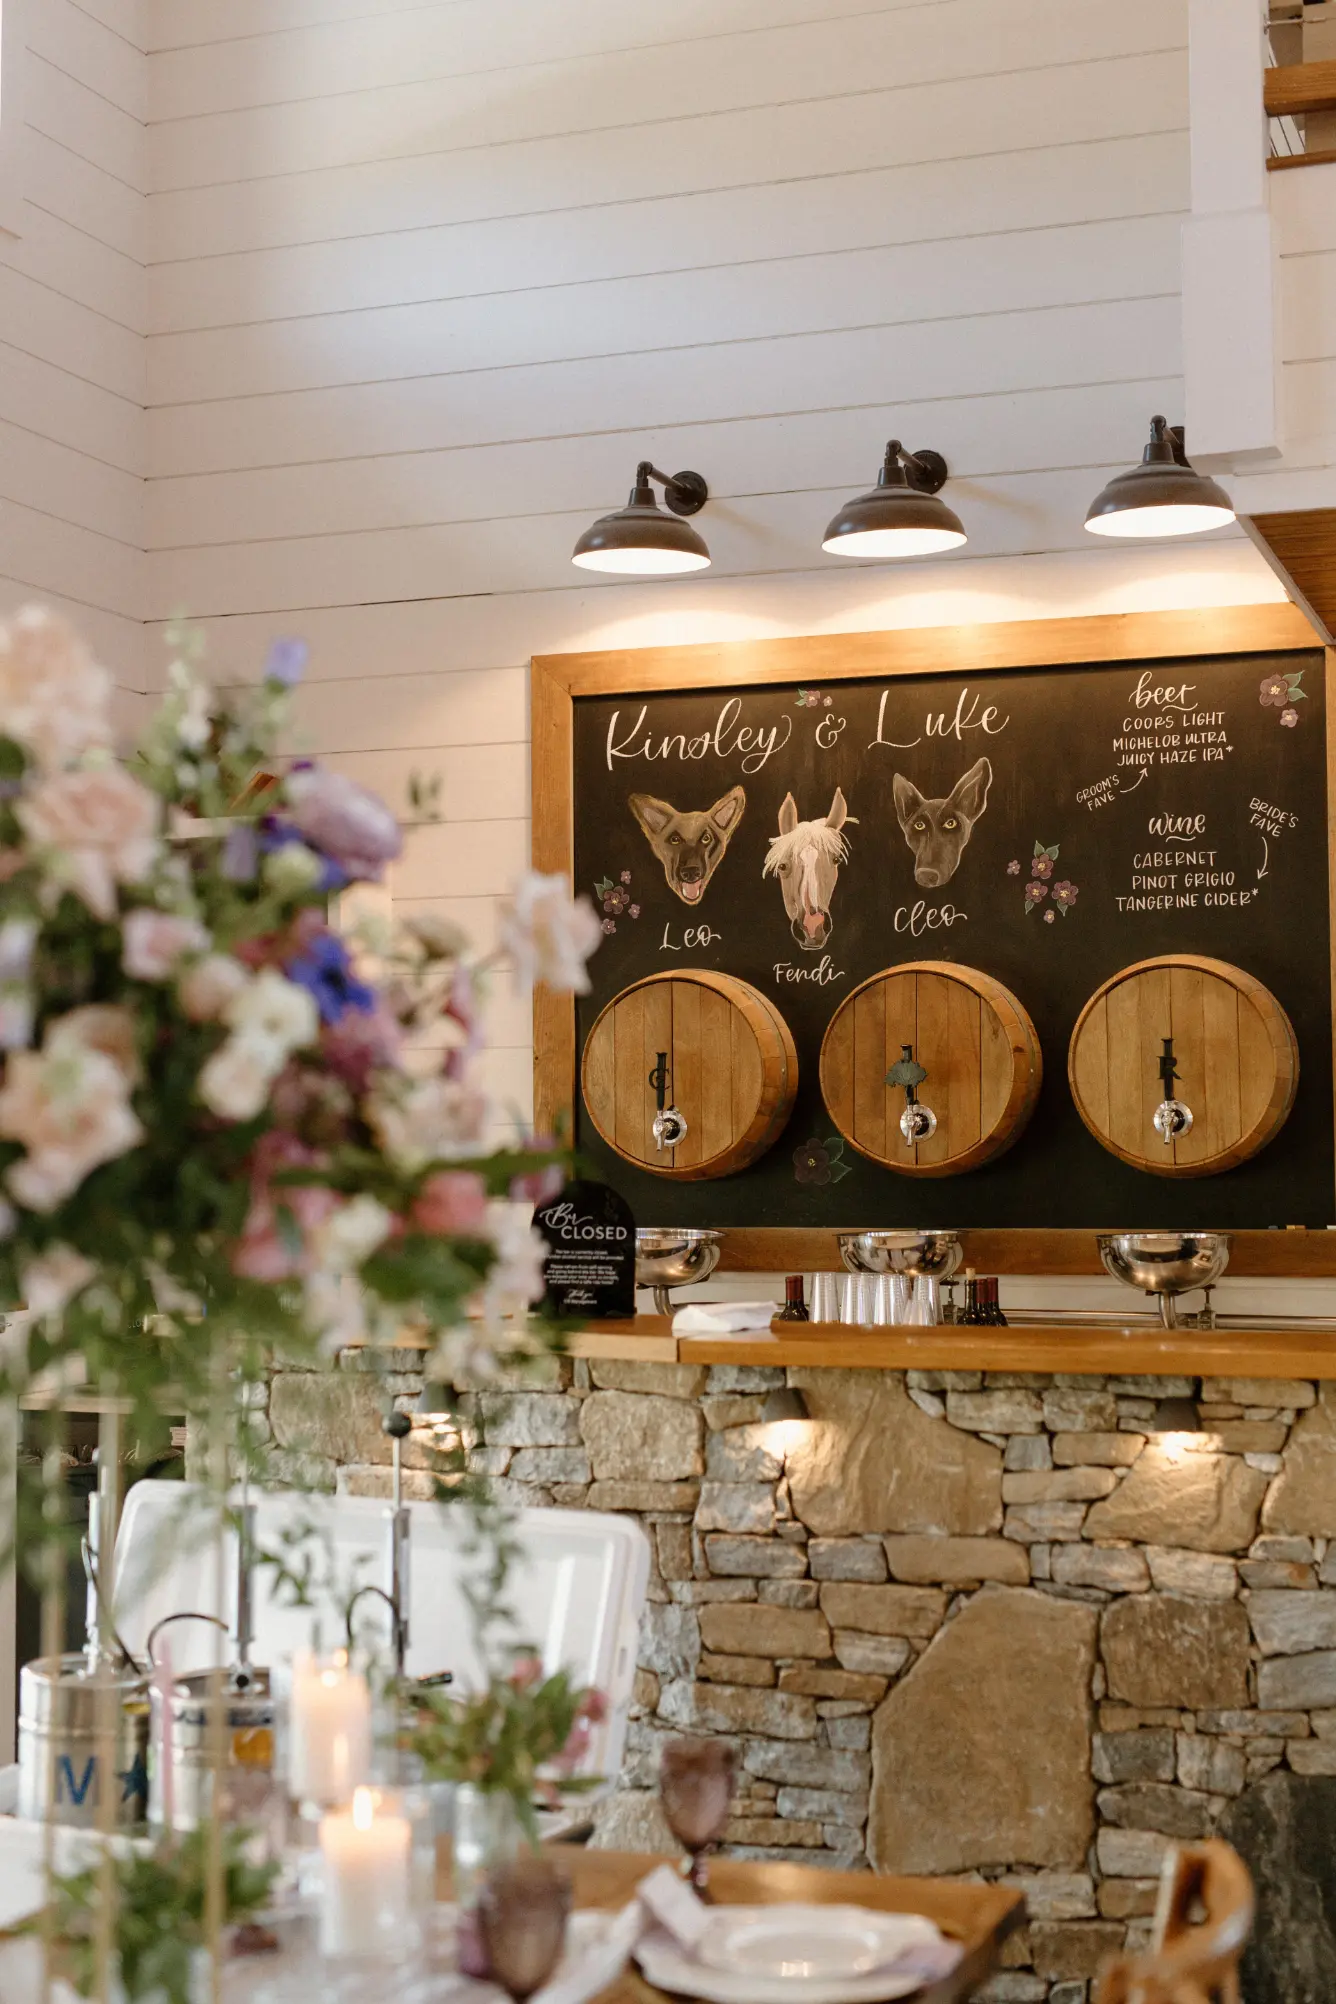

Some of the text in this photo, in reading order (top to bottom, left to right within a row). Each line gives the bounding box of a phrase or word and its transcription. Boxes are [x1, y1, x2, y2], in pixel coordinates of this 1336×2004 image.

[1128, 671, 1197, 709] beer
[605, 687, 1010, 774] Kinsley & Luke
[1122, 711, 1226, 732] COORS LIGHT
[1113, 730, 1227, 752] MICHELOB ULTRA
[1116, 752, 1155, 766] JUICY
[1160, 749, 1197, 764] HAZE
[1076, 774, 1120, 803] GROOM'S
[1087, 792, 1116, 811] FAVE
[1249, 797, 1299, 828] BRIDE'S
[1148, 812, 1206, 835] wine
[1249, 813, 1282, 837] FAVE
[1133, 851, 1217, 869] CABERNET
[1132, 871, 1235, 890] PINOT GRIGIO
[1115, 893, 1199, 911] TANGERINE
[658, 922, 722, 951] Leo
[772, 955, 846, 985] Fendi
[561, 1226, 627, 1239] CLOSED
